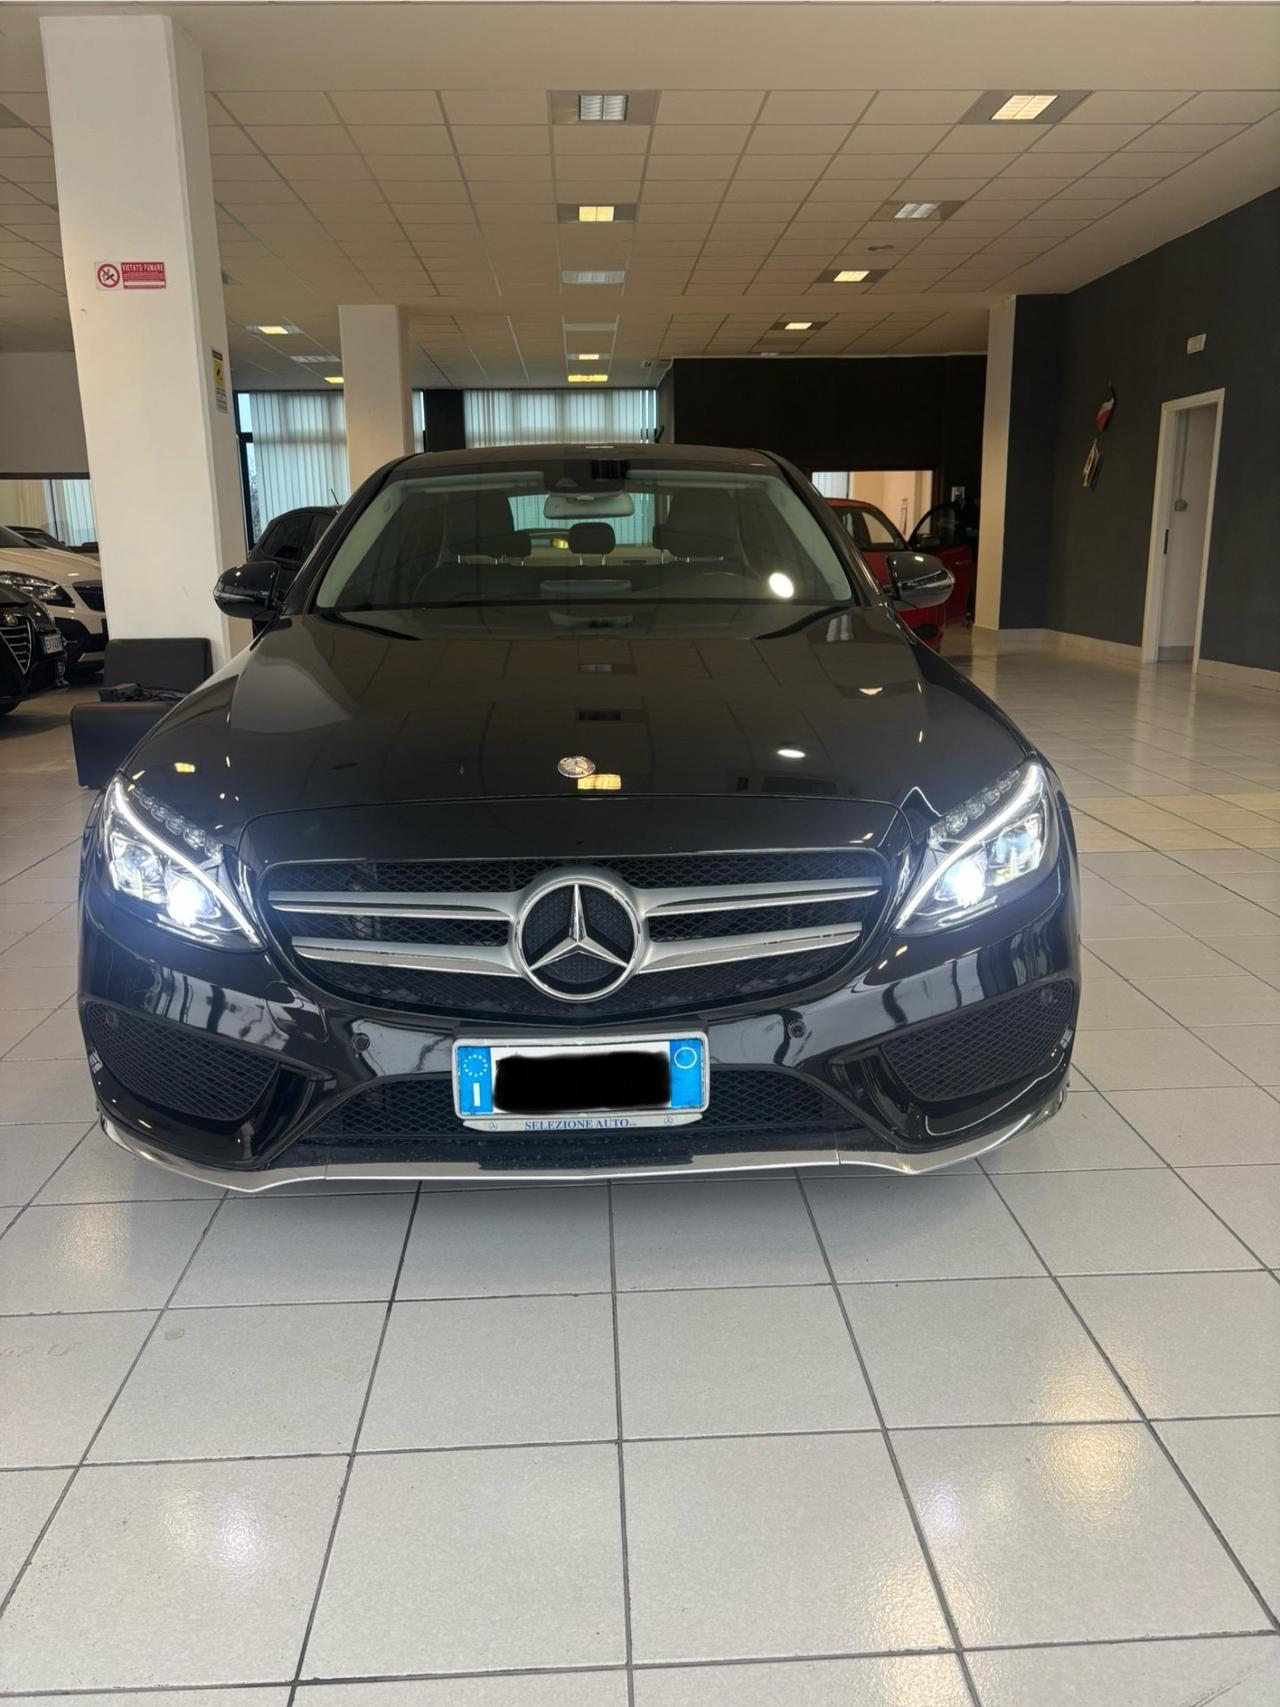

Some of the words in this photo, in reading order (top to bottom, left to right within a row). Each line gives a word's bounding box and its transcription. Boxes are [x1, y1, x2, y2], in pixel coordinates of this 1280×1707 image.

[473, 1082, 481, 1107] I
[524, 1120, 593, 1130] SELEZIONE
[596, 1118, 629, 1128] AUTO
